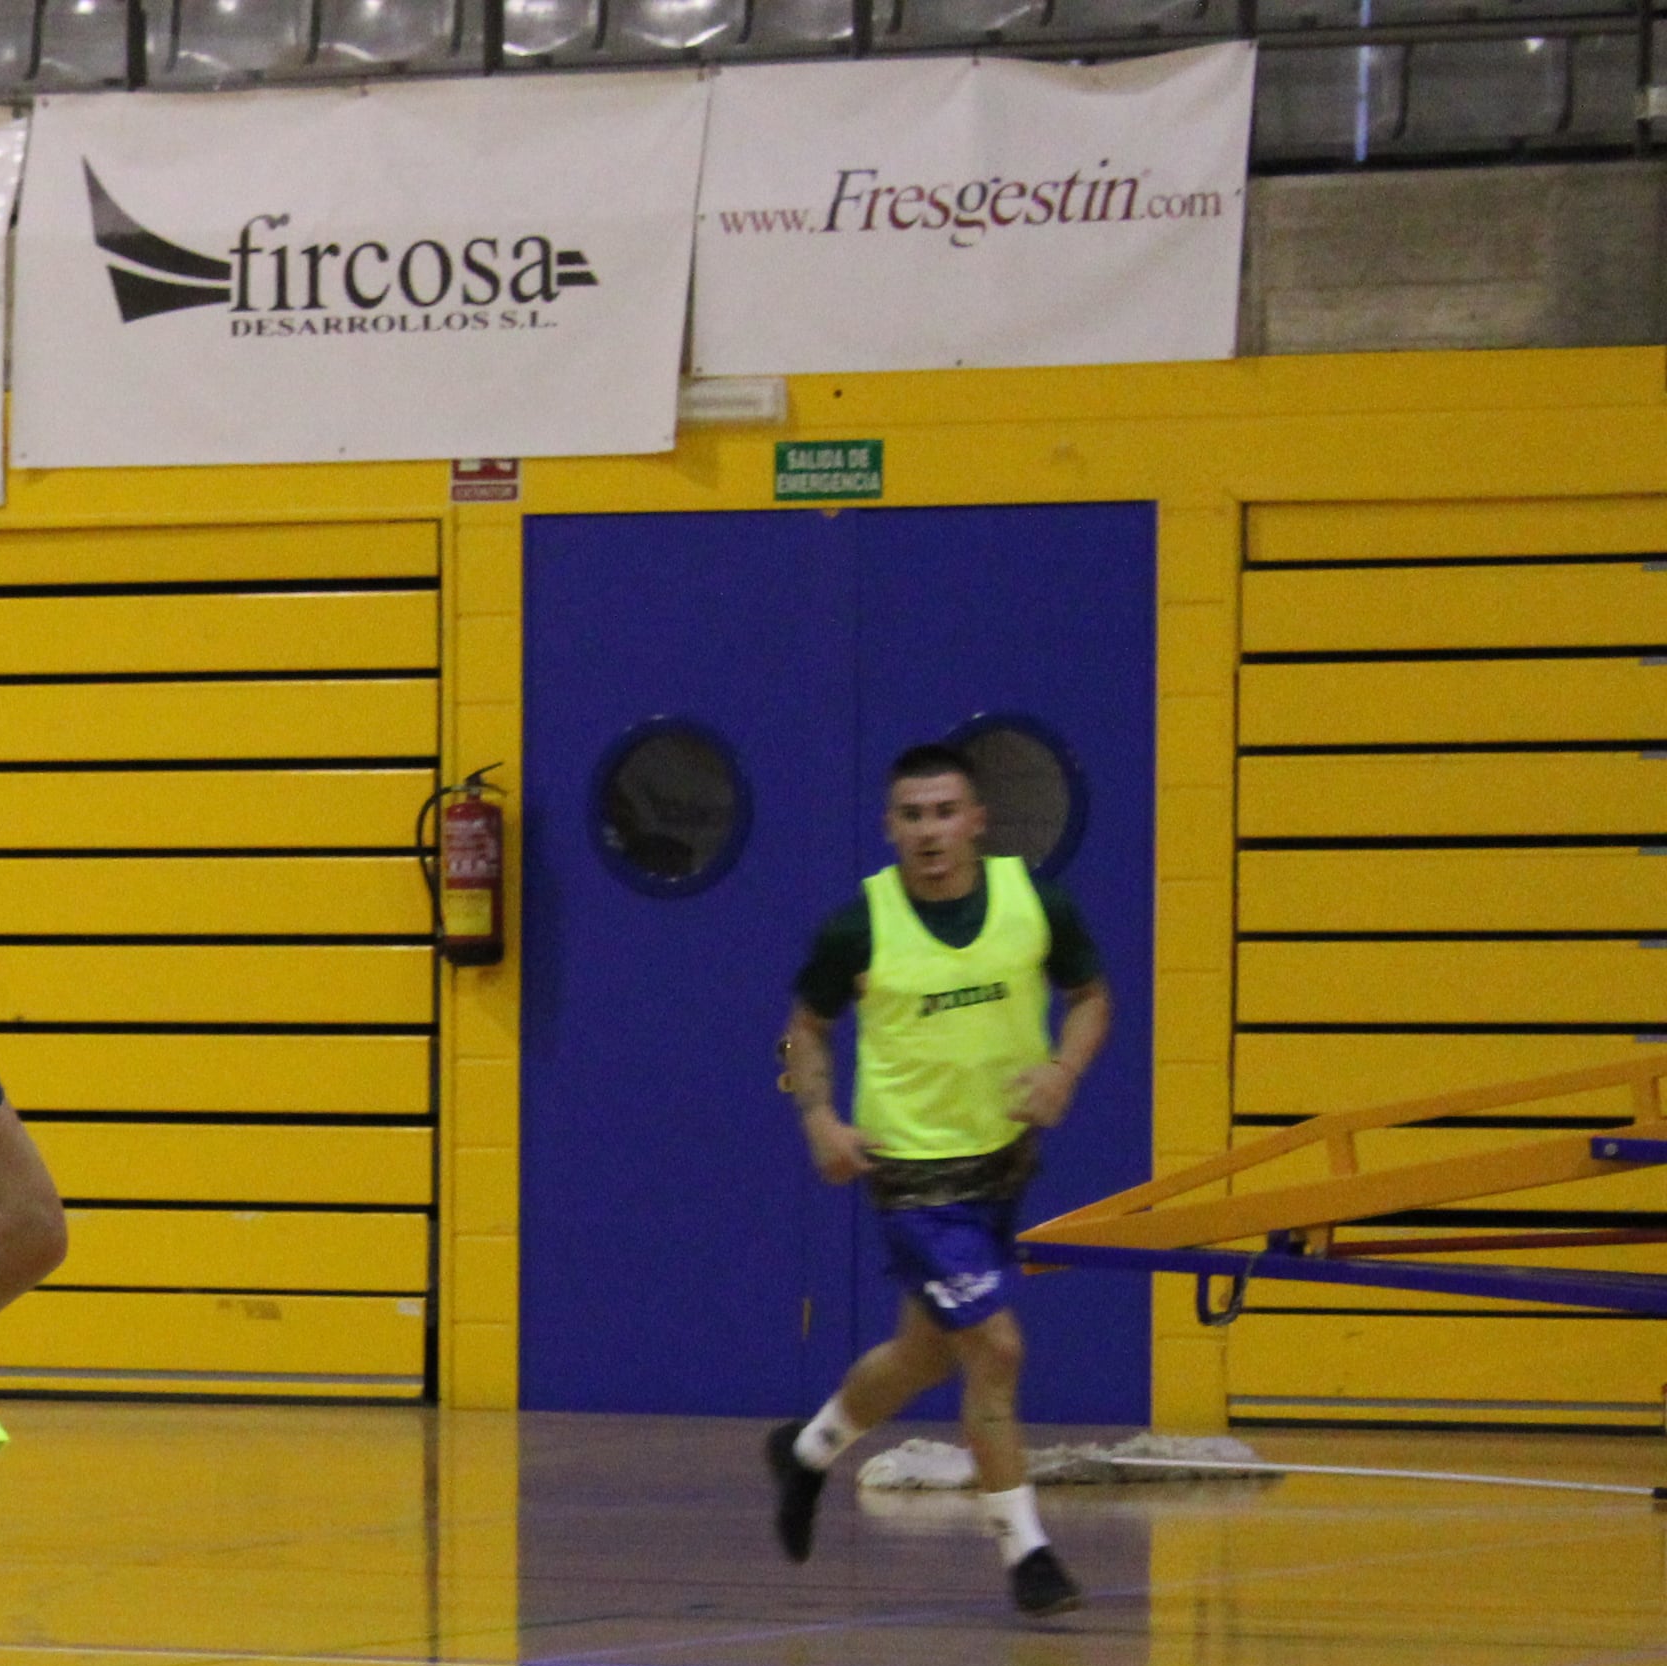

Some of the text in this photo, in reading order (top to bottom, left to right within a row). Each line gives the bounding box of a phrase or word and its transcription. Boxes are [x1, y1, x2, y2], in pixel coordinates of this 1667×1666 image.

[719, 157, 1223, 248] www.Fresgestin.com
[227, 212, 561, 313] fircosa
[230, 309, 559, 337] DESARROLLOS S.L.
